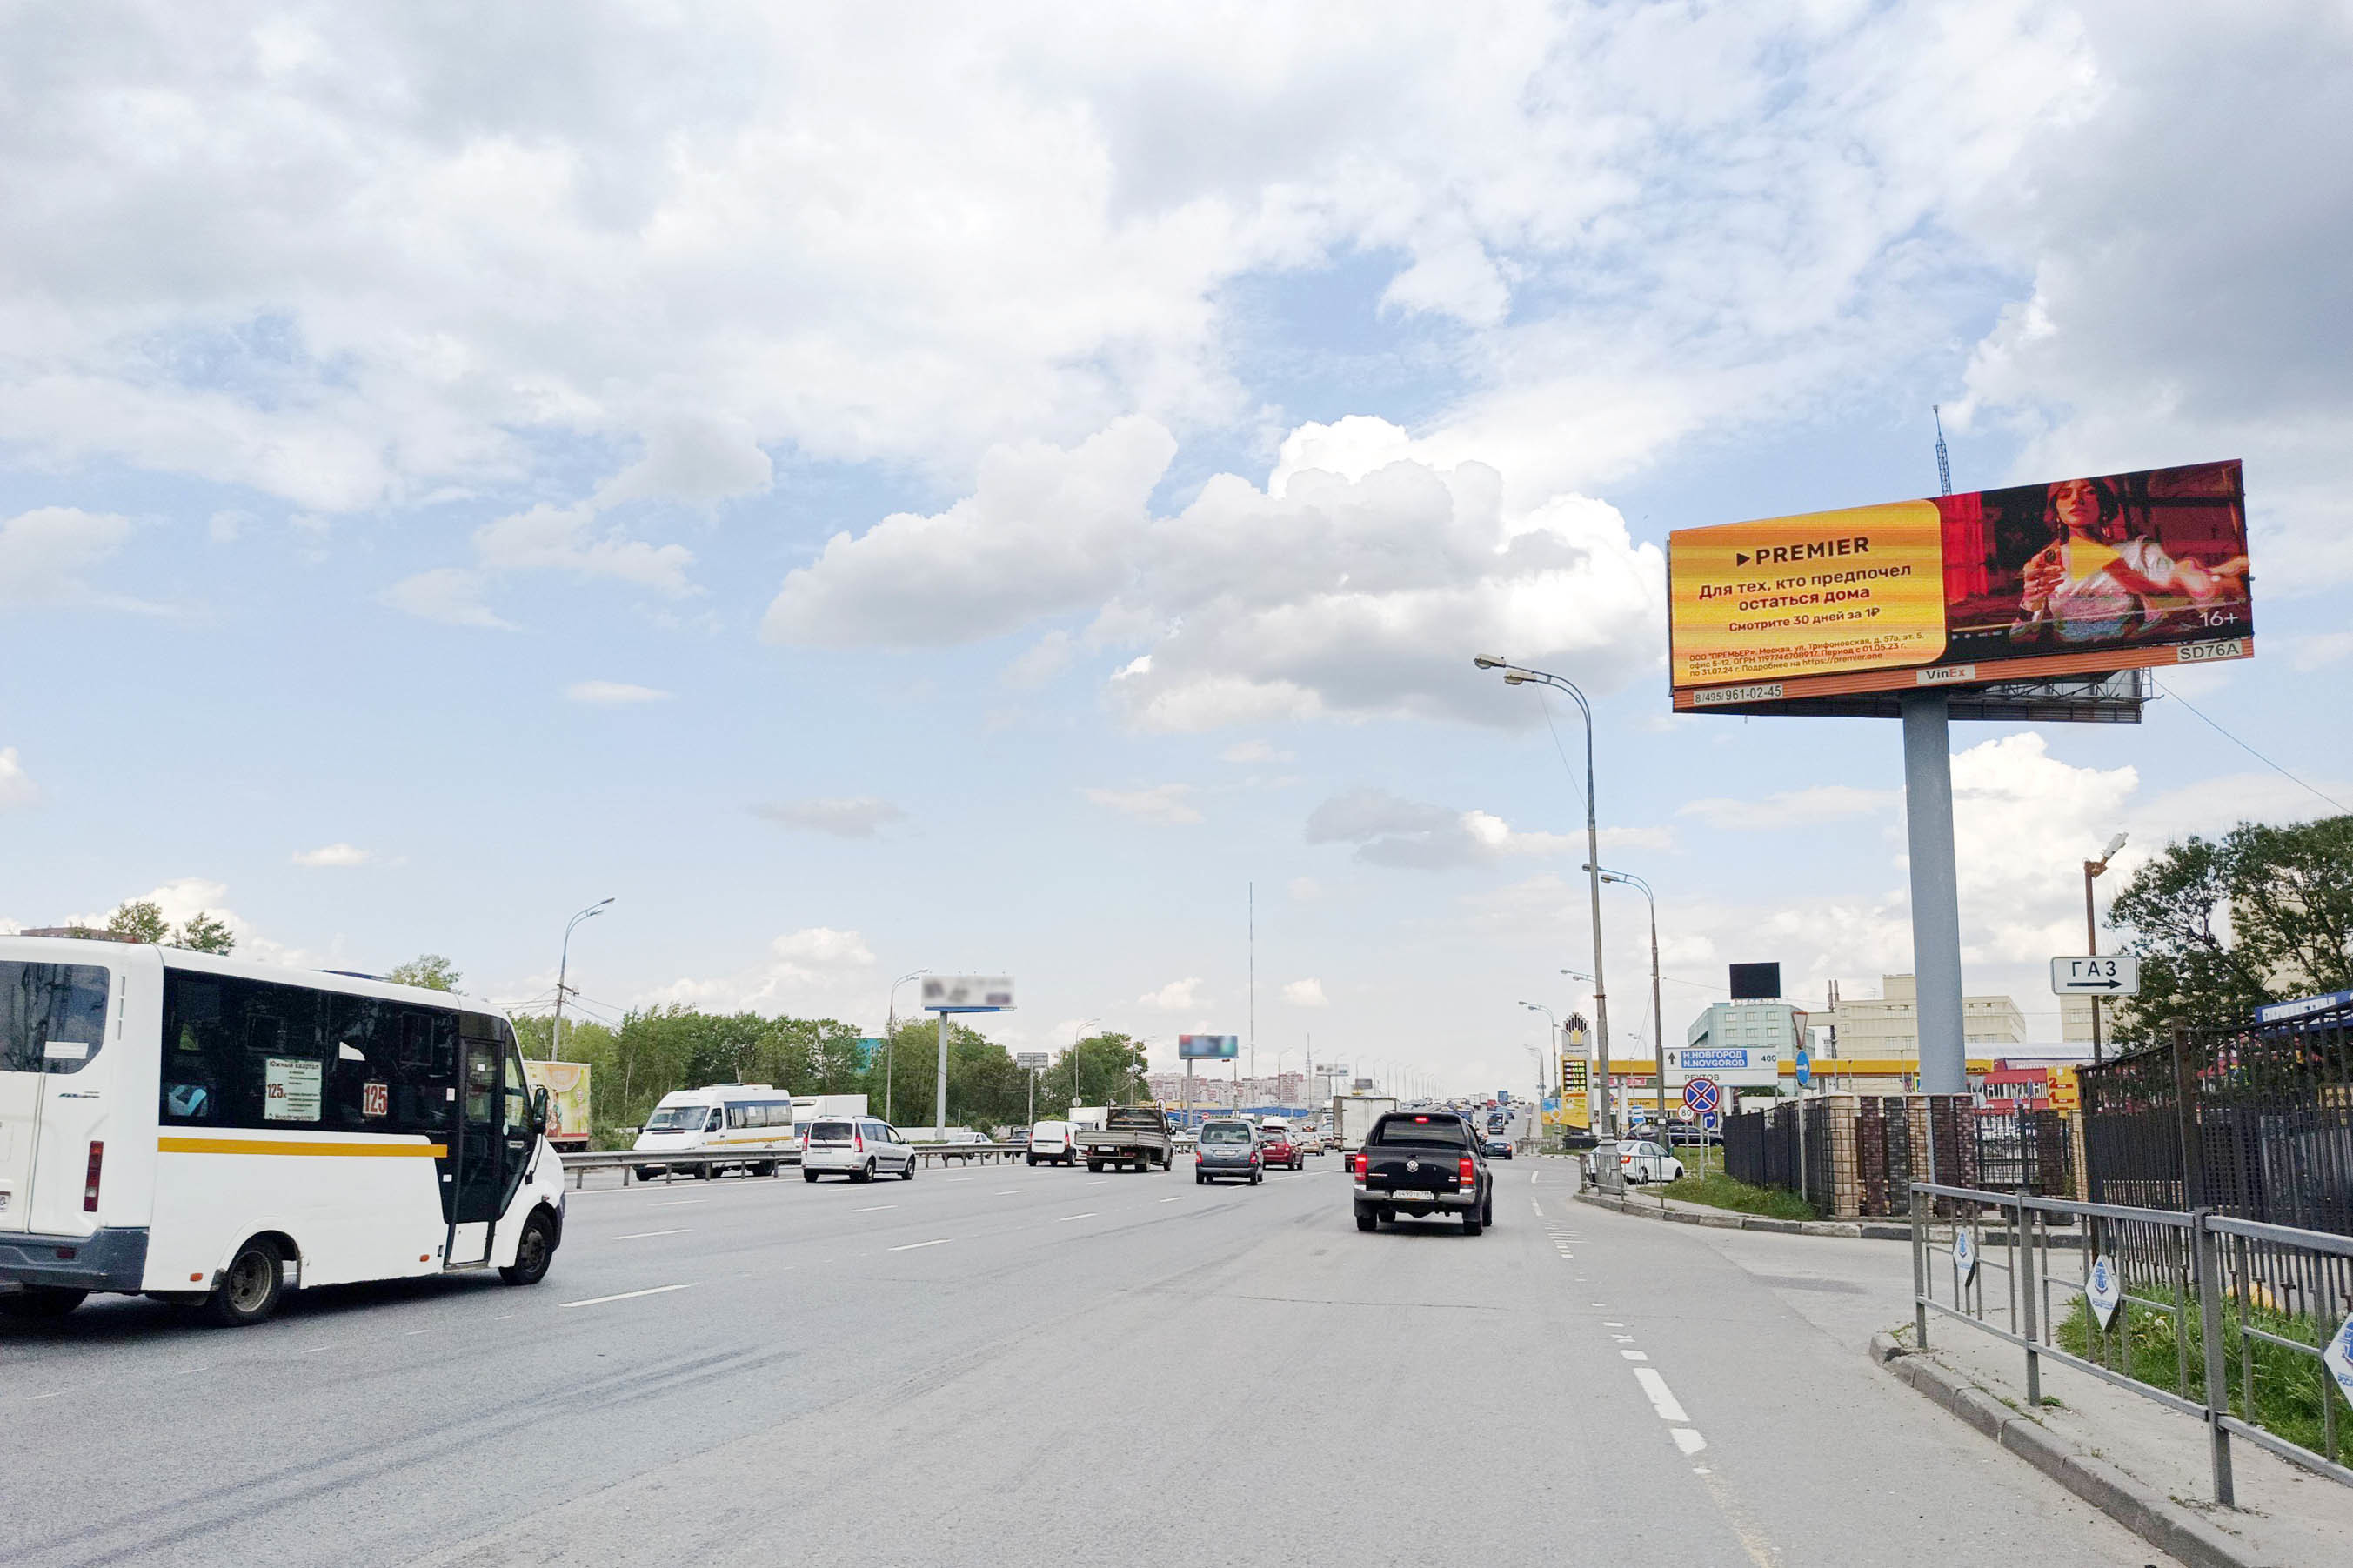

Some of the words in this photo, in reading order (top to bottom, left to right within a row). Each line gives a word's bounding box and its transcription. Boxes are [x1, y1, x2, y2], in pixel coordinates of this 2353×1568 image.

[1756, 537, 1869, 564] PREMIER
[1699, 584, 1733, 600] Для
[1737, 581, 1771, 593] тех,
[1776, 577, 1806, 589] кто
[1811, 565, 1911, 587] предпочел
[1739, 593, 1819, 611] остаться
[1823, 588, 1870, 604] дома
[1729, 618, 1790, 631] Смотрите
[1794, 615, 1809, 625] 30
[1812, 613, 1844, 625] дней
[1847, 611, 1862, 620] за
[2198, 611, 2239, 627] 16+
[2180, 643, 2239, 660] SD76A
[1925, 669, 1966, 680] VinEx
[2072, 961, 2116, 977] ГАЗ
[364, 1085, 388, 1113] 125
